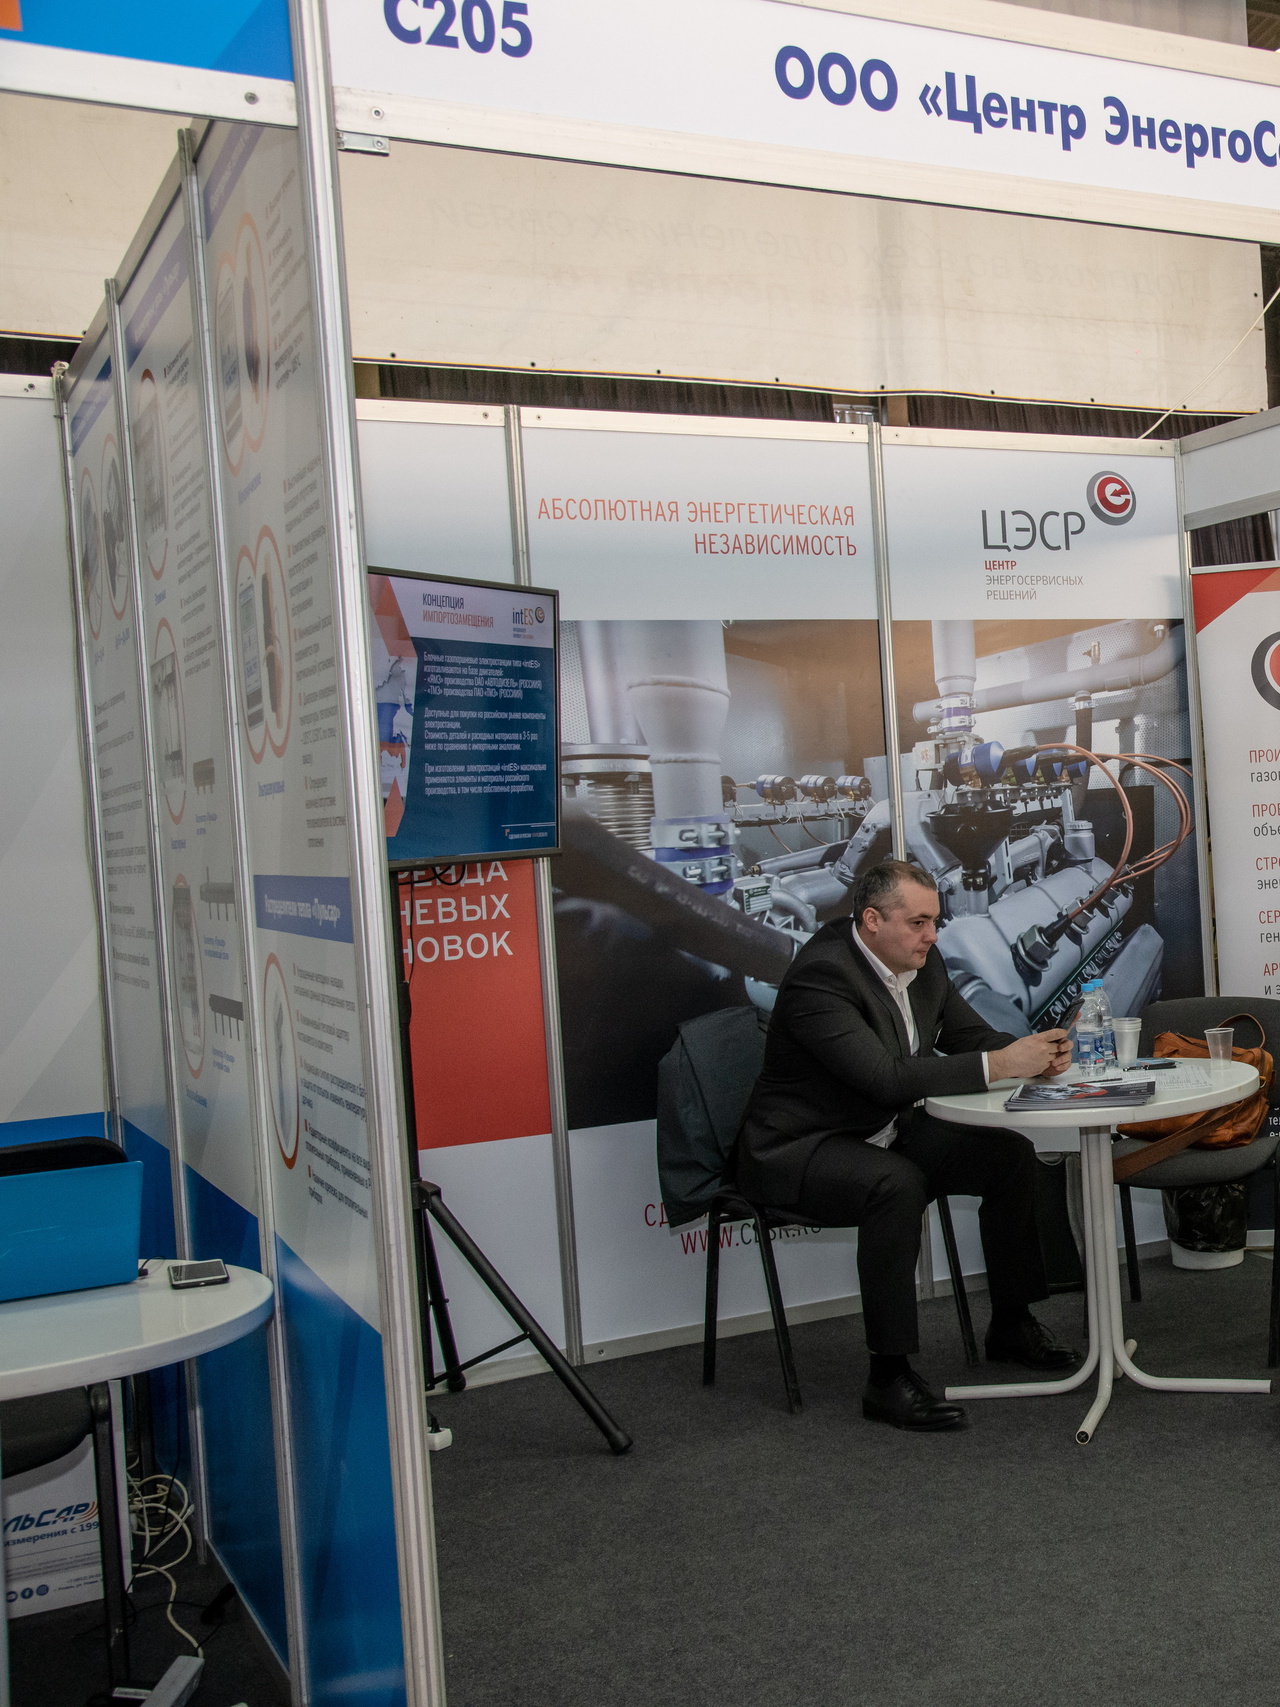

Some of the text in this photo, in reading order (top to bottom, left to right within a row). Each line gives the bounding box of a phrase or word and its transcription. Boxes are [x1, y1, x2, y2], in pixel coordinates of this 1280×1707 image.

[775, 45, 898, 112] ООО
[918, 70, 1088, 152] «Центр
[538, 498, 855, 526] АБСОЛЮТНАЯ ЭНЕРГЕТИЧЕСКАЯ
[982, 510, 1086, 552] ЦЭСР
[694, 533, 857, 556] НЕЗАВИСИМОСТЬ
[984, 560, 1017, 571] ЦЕНТР
[986, 575, 1084, 586] ЭНЕРГОСЕРВИСНЫХ
[423, 593, 464, 609] КОНЦЕПЦИЯ
[986, 588, 1037, 601] РЕШЕНИЙ
[423, 610, 494, 628] ИМПОРТОЗАМЕЩЕНИЯ
[512, 607, 534, 626] intES
[398, 861, 509, 887] ЕНДА
[1265, 985, 1272, 995] и
[3, 1502, 90, 1533] ЛЬСАР
